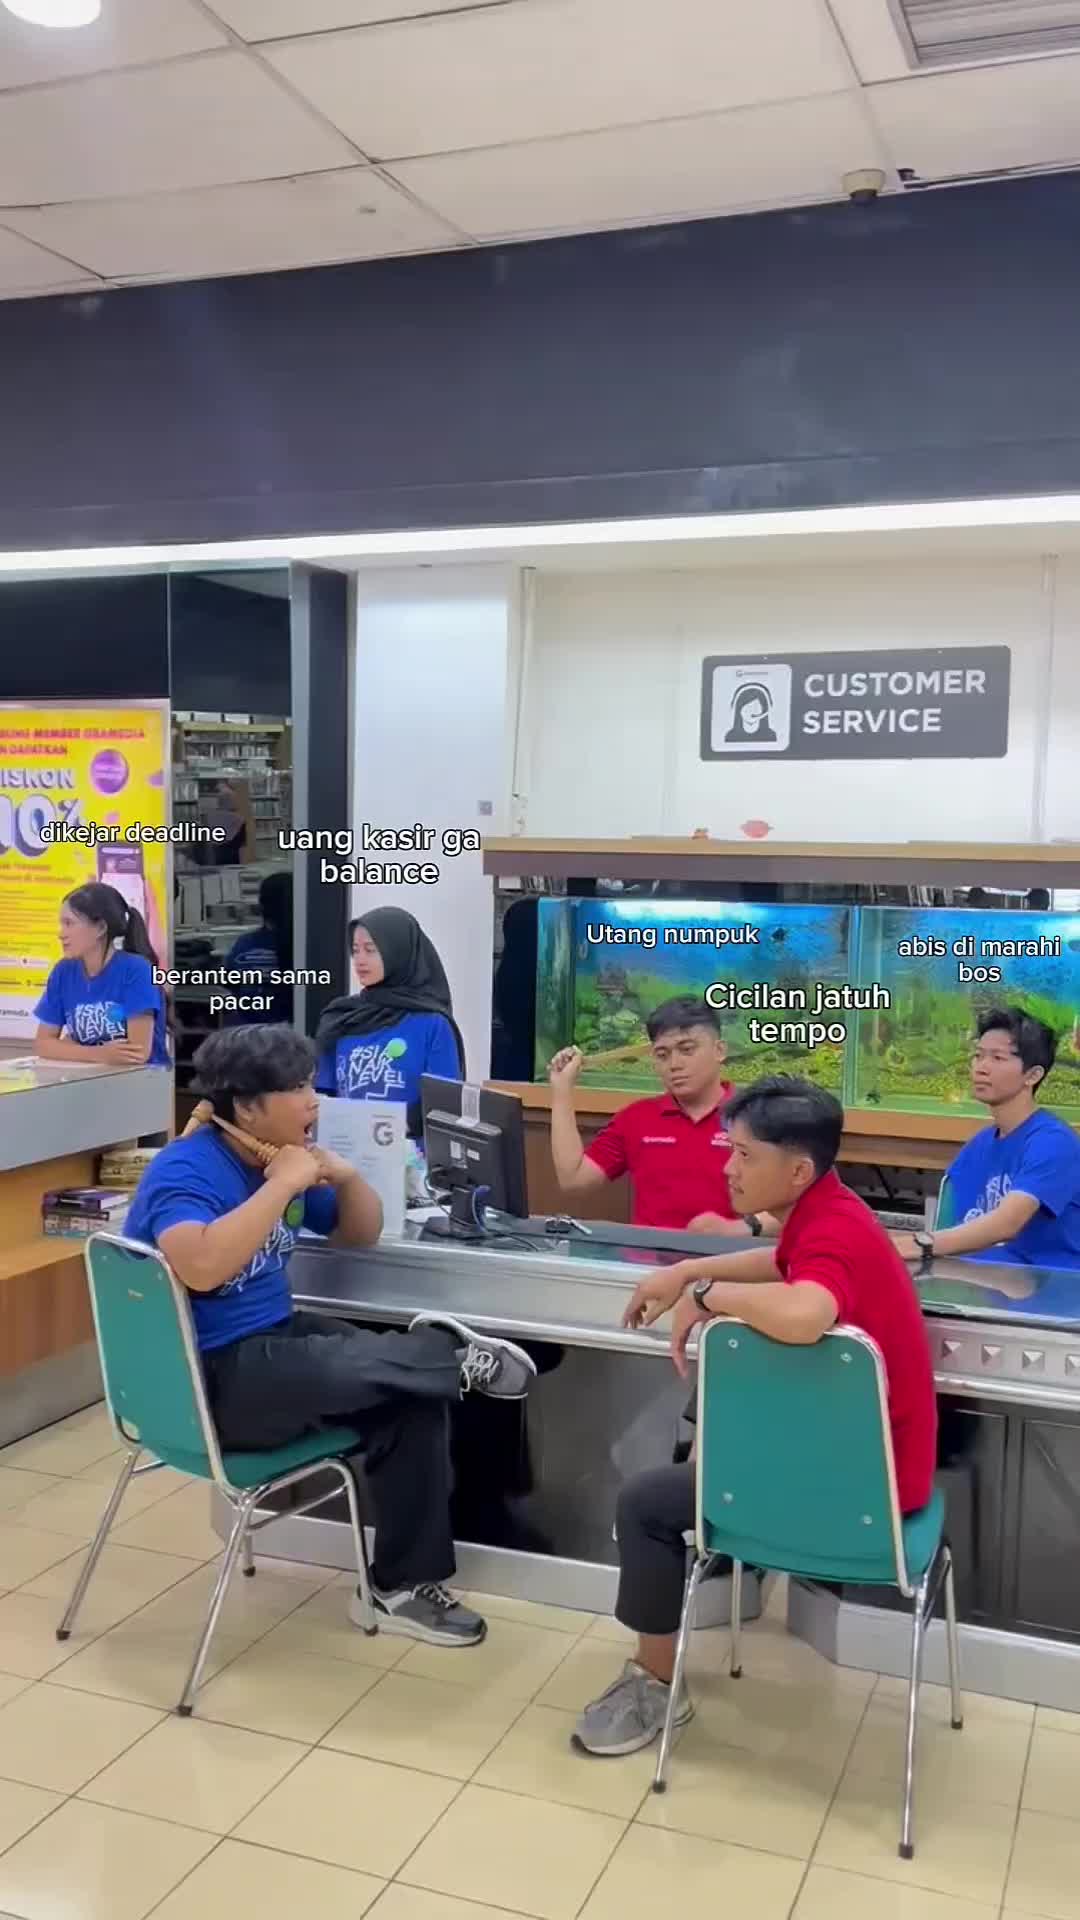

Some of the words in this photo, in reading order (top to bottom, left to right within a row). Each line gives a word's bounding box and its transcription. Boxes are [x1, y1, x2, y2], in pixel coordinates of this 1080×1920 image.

[803, 669, 987, 698] CUSTOMER
[802, 707, 943, 735] SERVICE
[349, 1057, 394, 1076] NAIK
[348, 1070, 406, 1092] LEVEL
[373, 1121, 395, 1147] G
